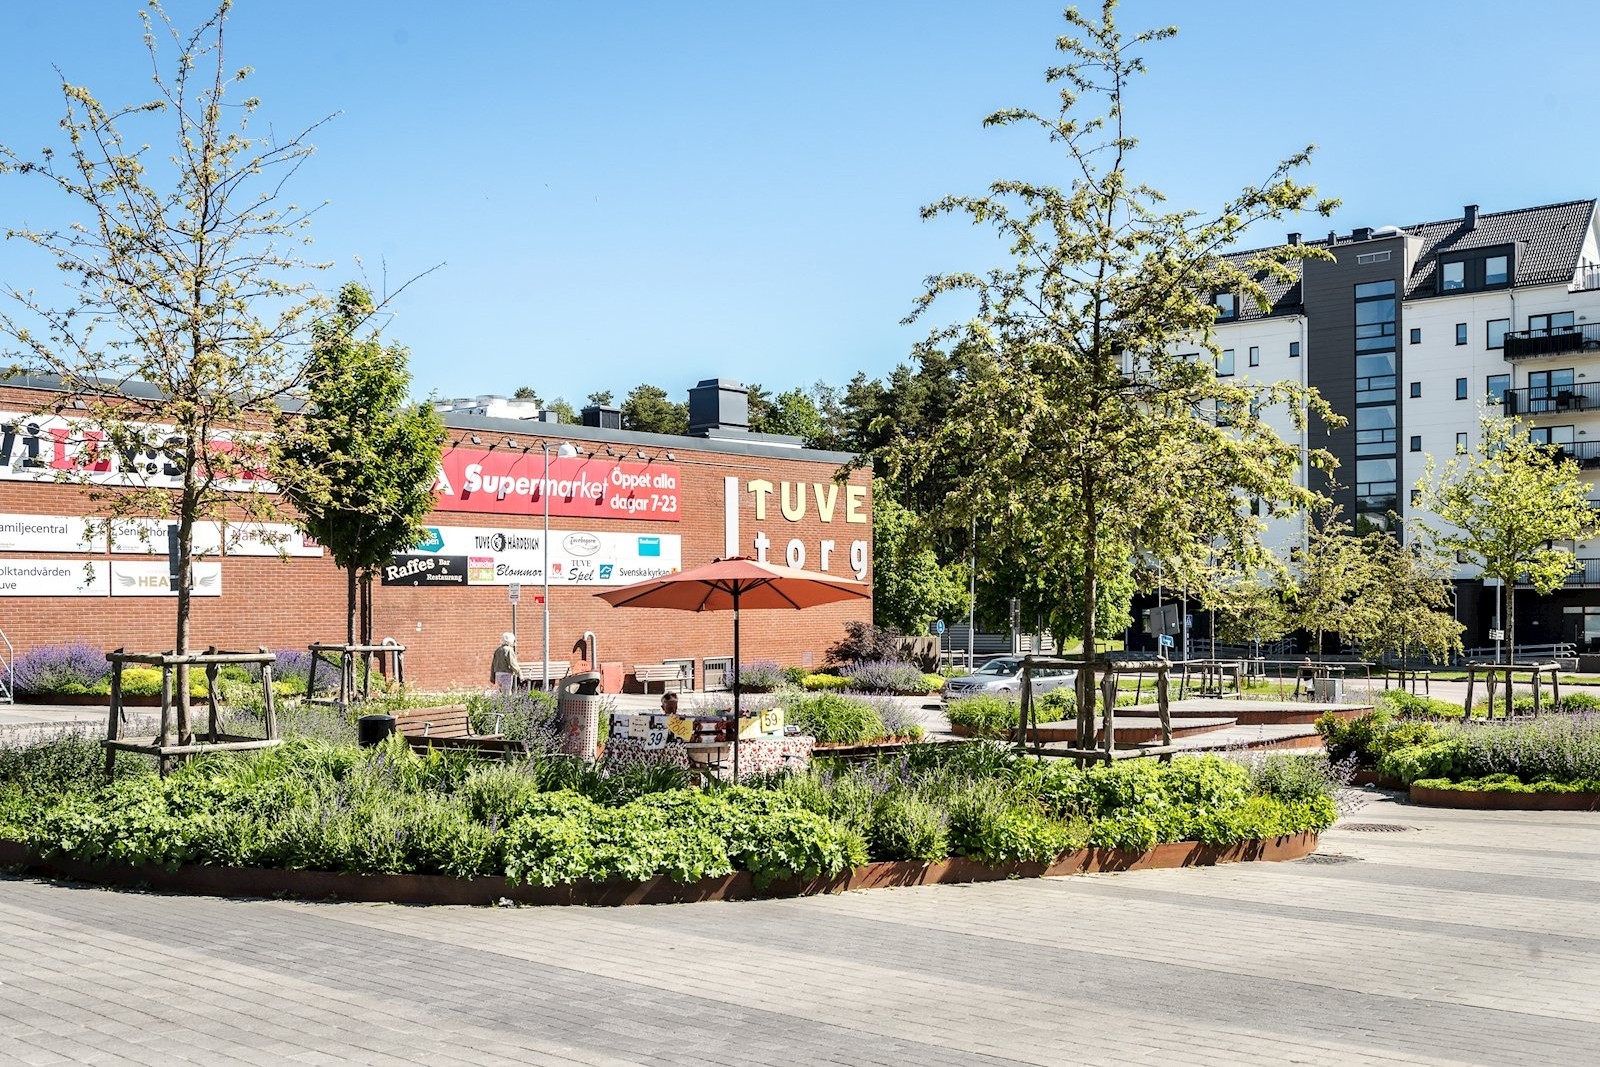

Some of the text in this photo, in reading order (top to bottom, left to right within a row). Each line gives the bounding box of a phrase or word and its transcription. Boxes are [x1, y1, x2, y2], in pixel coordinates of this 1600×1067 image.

[463, 463, 608, 500] Supermarket
[611, 467, 675, 489] Öppet alla
[610, 494, 677, 513] dagar 7-23
[747, 479, 867, 523] TUVE
[475, 536, 490, 549] TUVE
[754, 531, 868, 581] torg
[386, 558, 435, 581] Raffes
[426, 574, 463, 583] Restaurang
[496, 564, 543, 576] Blommor
[568, 568, 595, 584] Spel
[619, 568, 647, 577] Svenska
